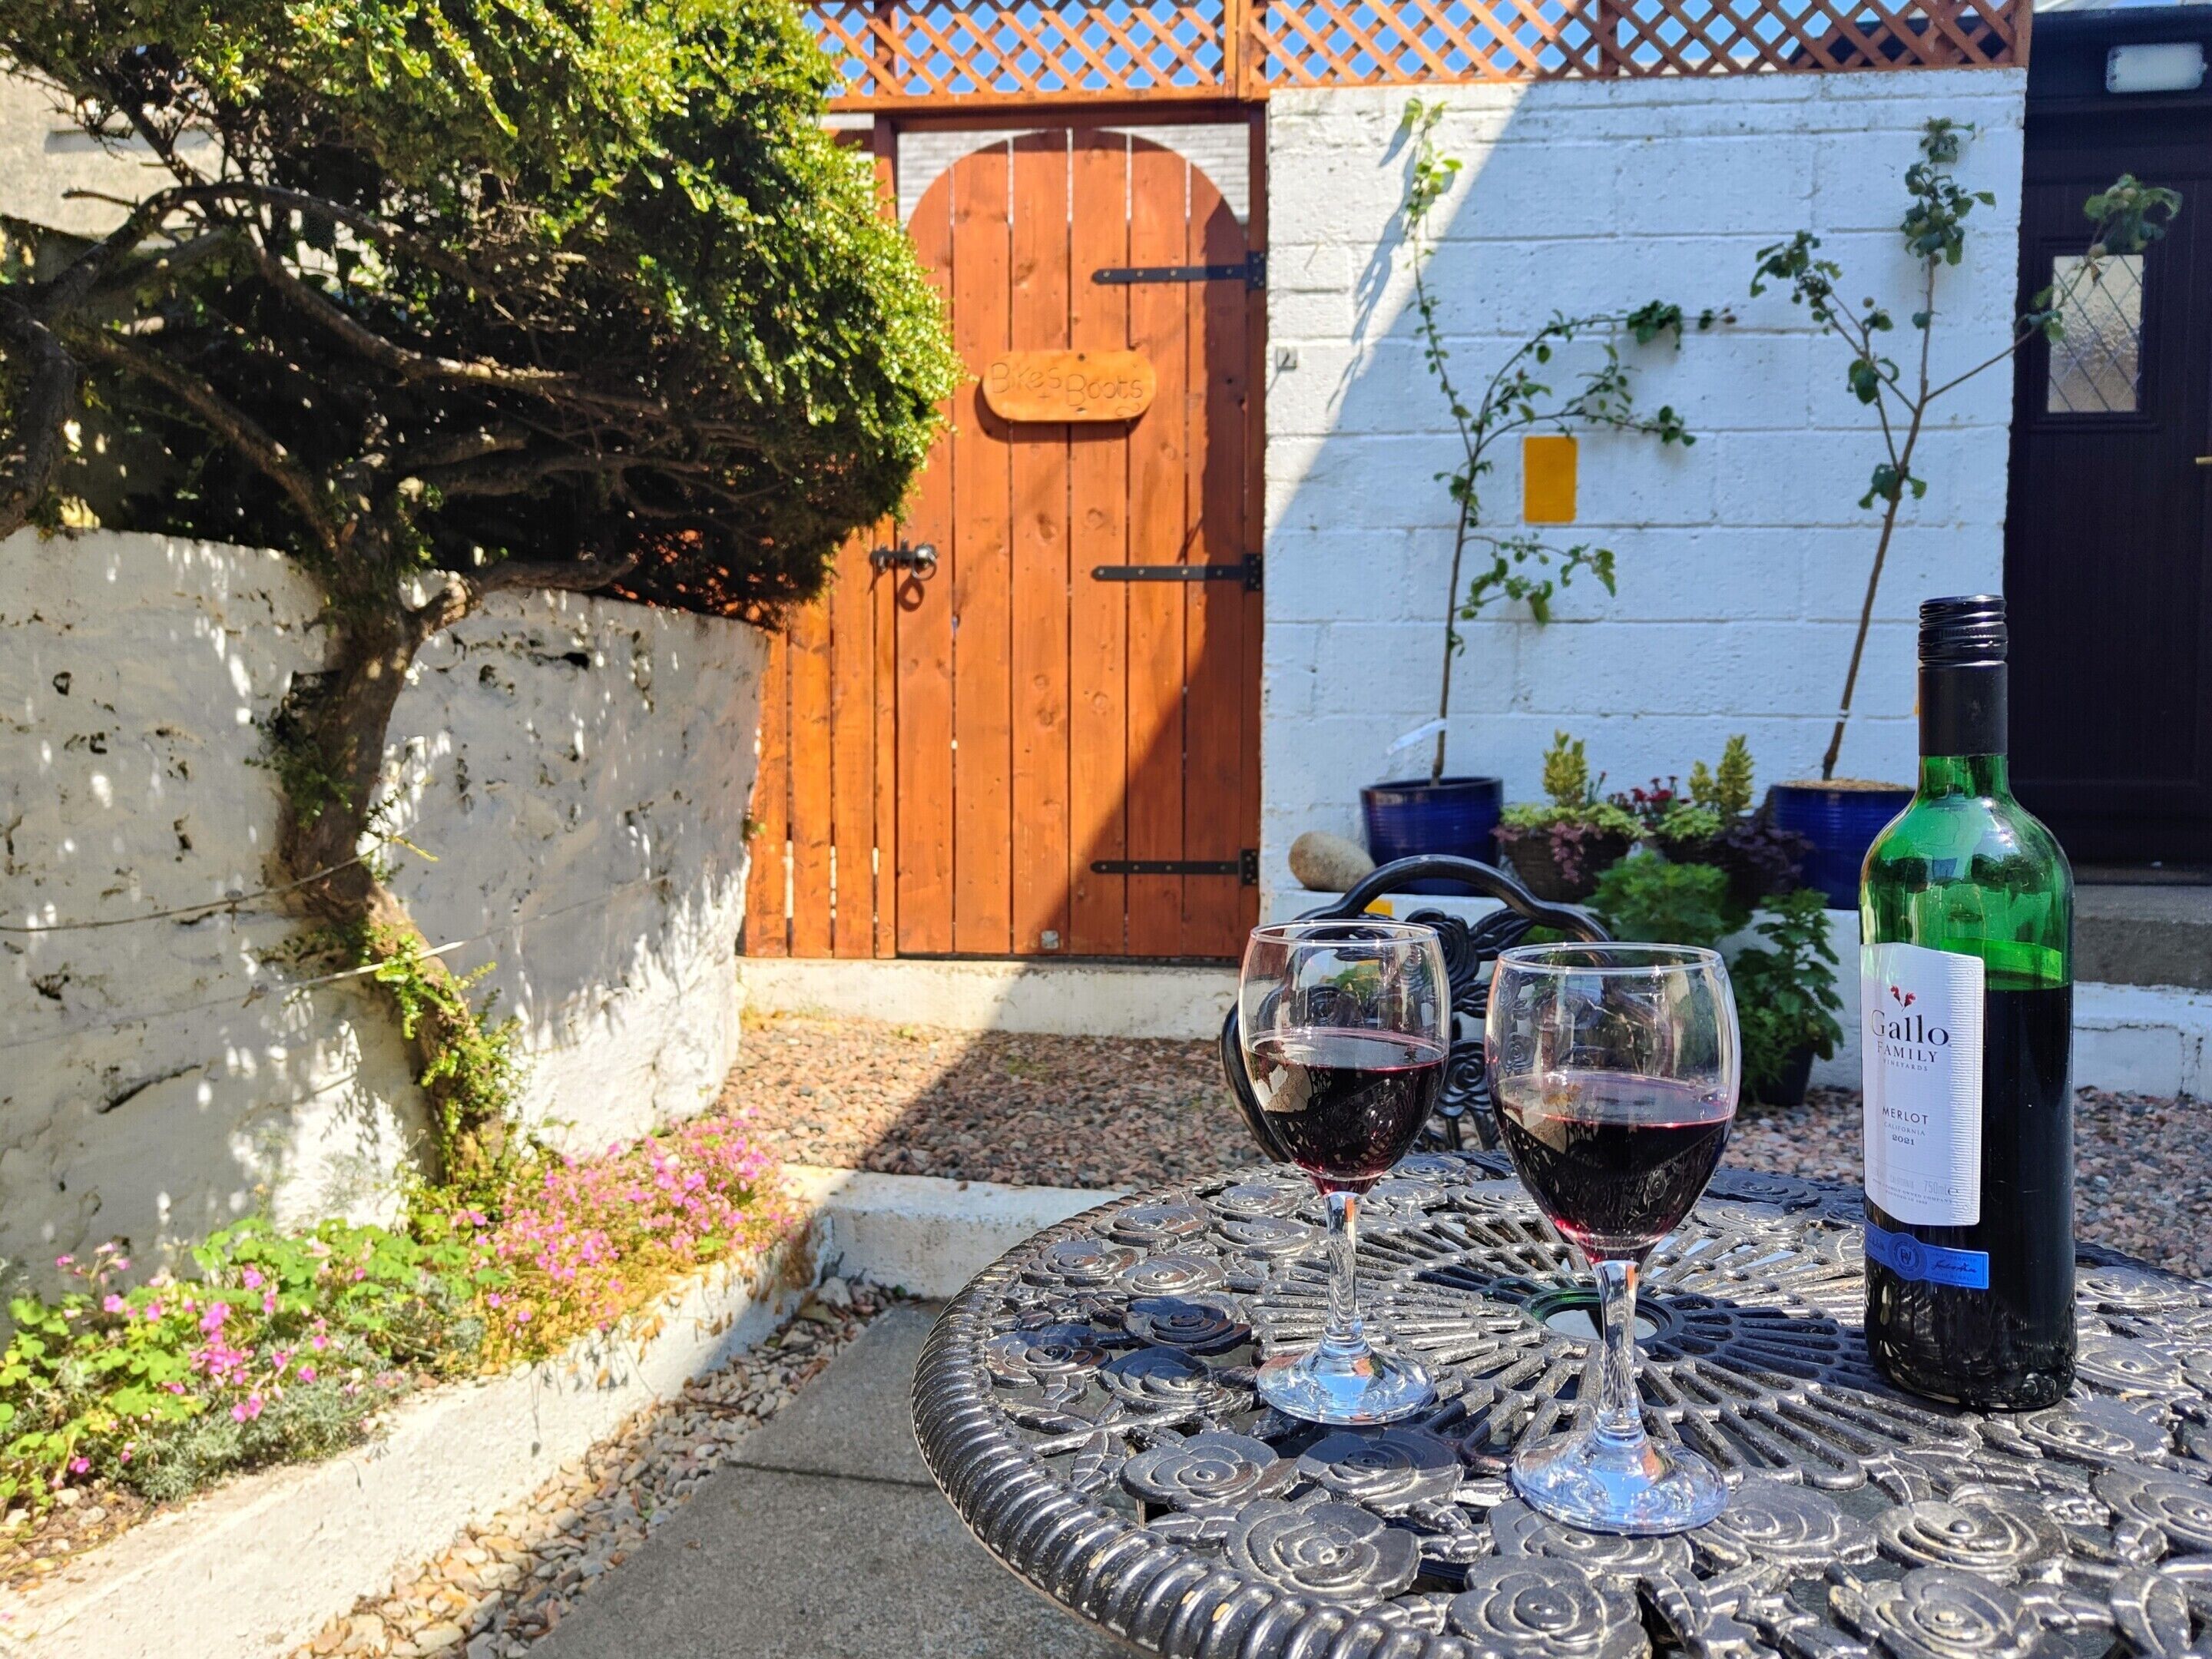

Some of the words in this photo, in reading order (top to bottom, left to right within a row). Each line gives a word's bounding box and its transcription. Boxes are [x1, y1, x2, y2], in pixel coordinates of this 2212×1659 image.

[1065, 373, 1144, 407] Boots
[1871, 1008, 1949, 1047] Gallo
[1876, 1040, 1939, 1063] FAMILY
[1883, 1058, 1929, 1071] VINEYARDS
[1882, 1105, 1929, 1125] MERLOT
[1883, 1121, 1926, 1137] CALIFORNIA
[1891, 1133, 1916, 1146] 2021
